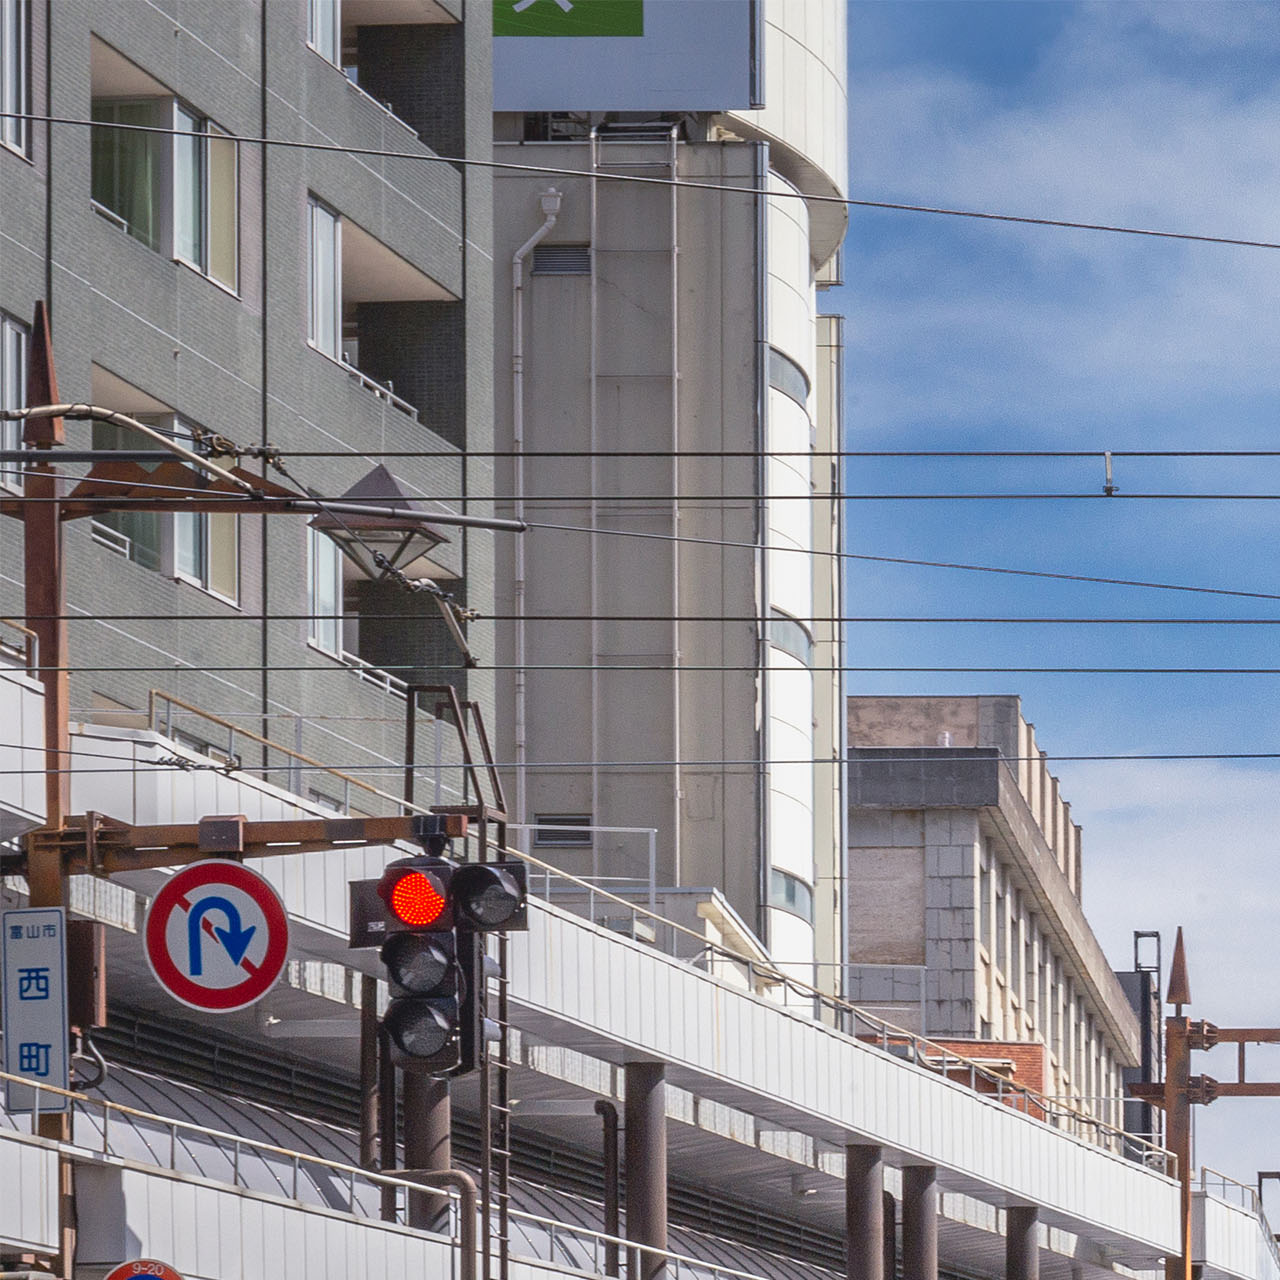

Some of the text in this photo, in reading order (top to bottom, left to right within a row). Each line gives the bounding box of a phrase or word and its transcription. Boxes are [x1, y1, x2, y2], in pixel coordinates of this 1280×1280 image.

[9, 924, 57, 940] 富山市
[17, 967, 52, 1077] 西町
[132, 1263, 165, 1276] 9-20
